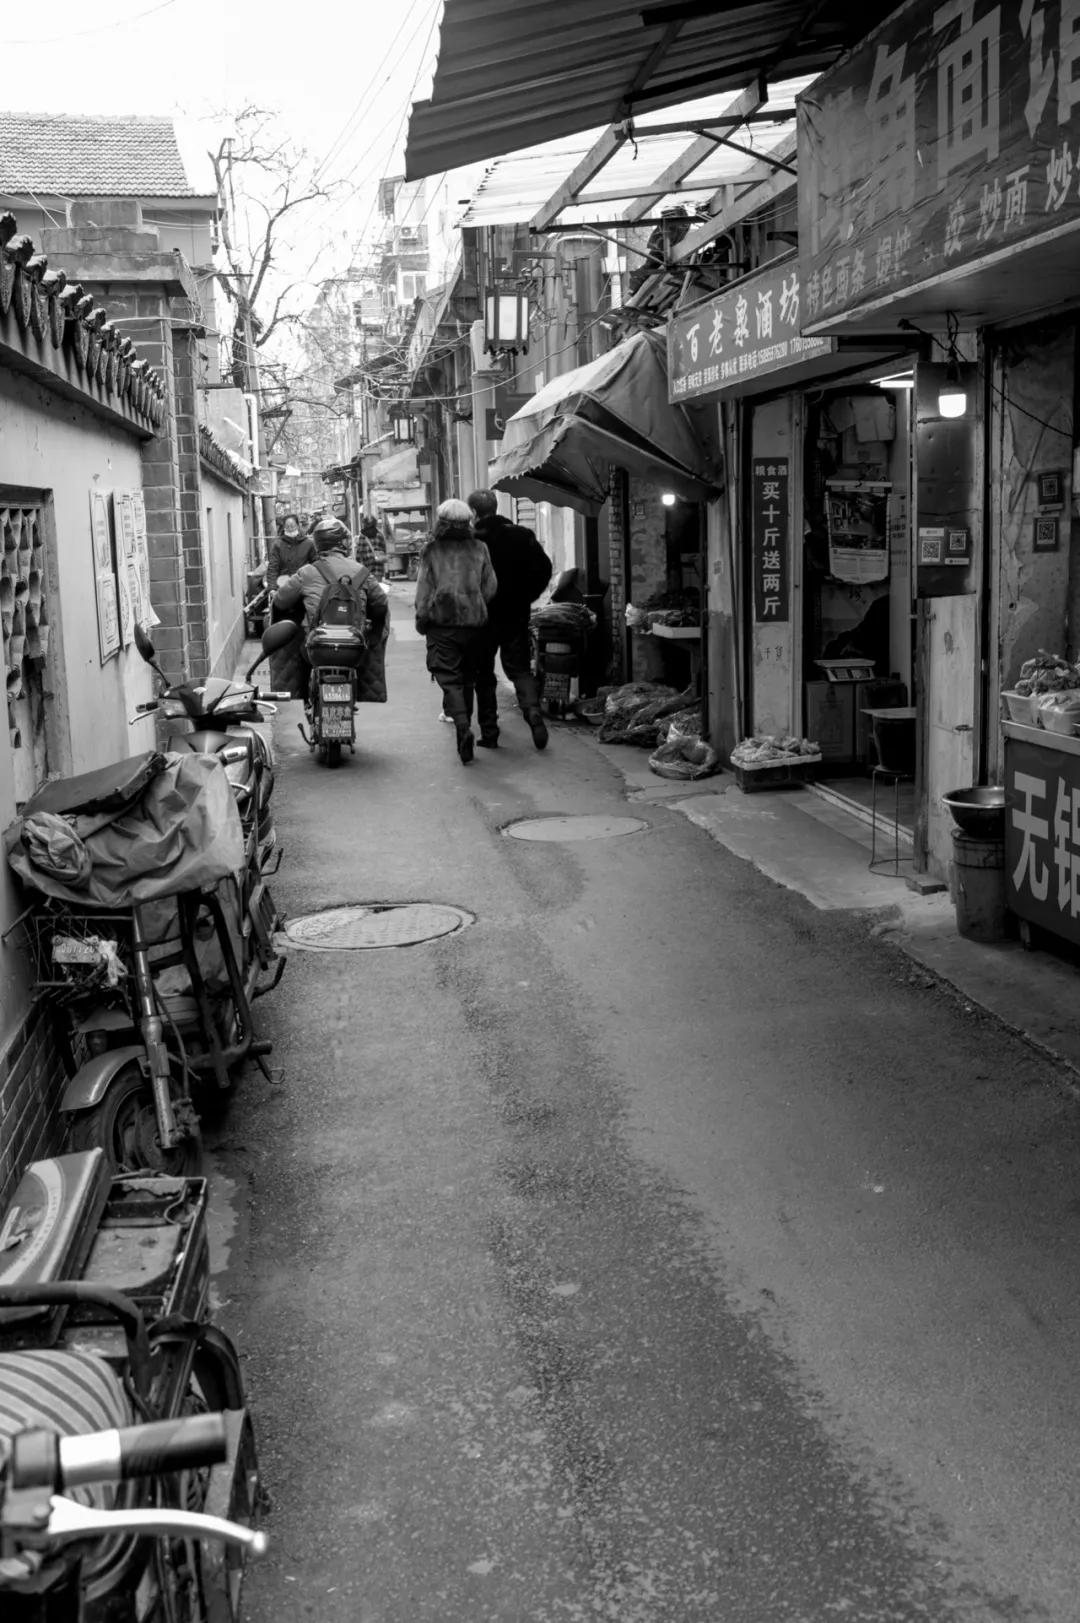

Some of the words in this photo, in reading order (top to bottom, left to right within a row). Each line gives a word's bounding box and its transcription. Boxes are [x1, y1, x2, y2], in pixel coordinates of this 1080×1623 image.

[976, 164, 1031, 234] 炒面
[1045, 141, 1080, 212] 炒
[762, 481, 782, 616] 买十斤送两斤
